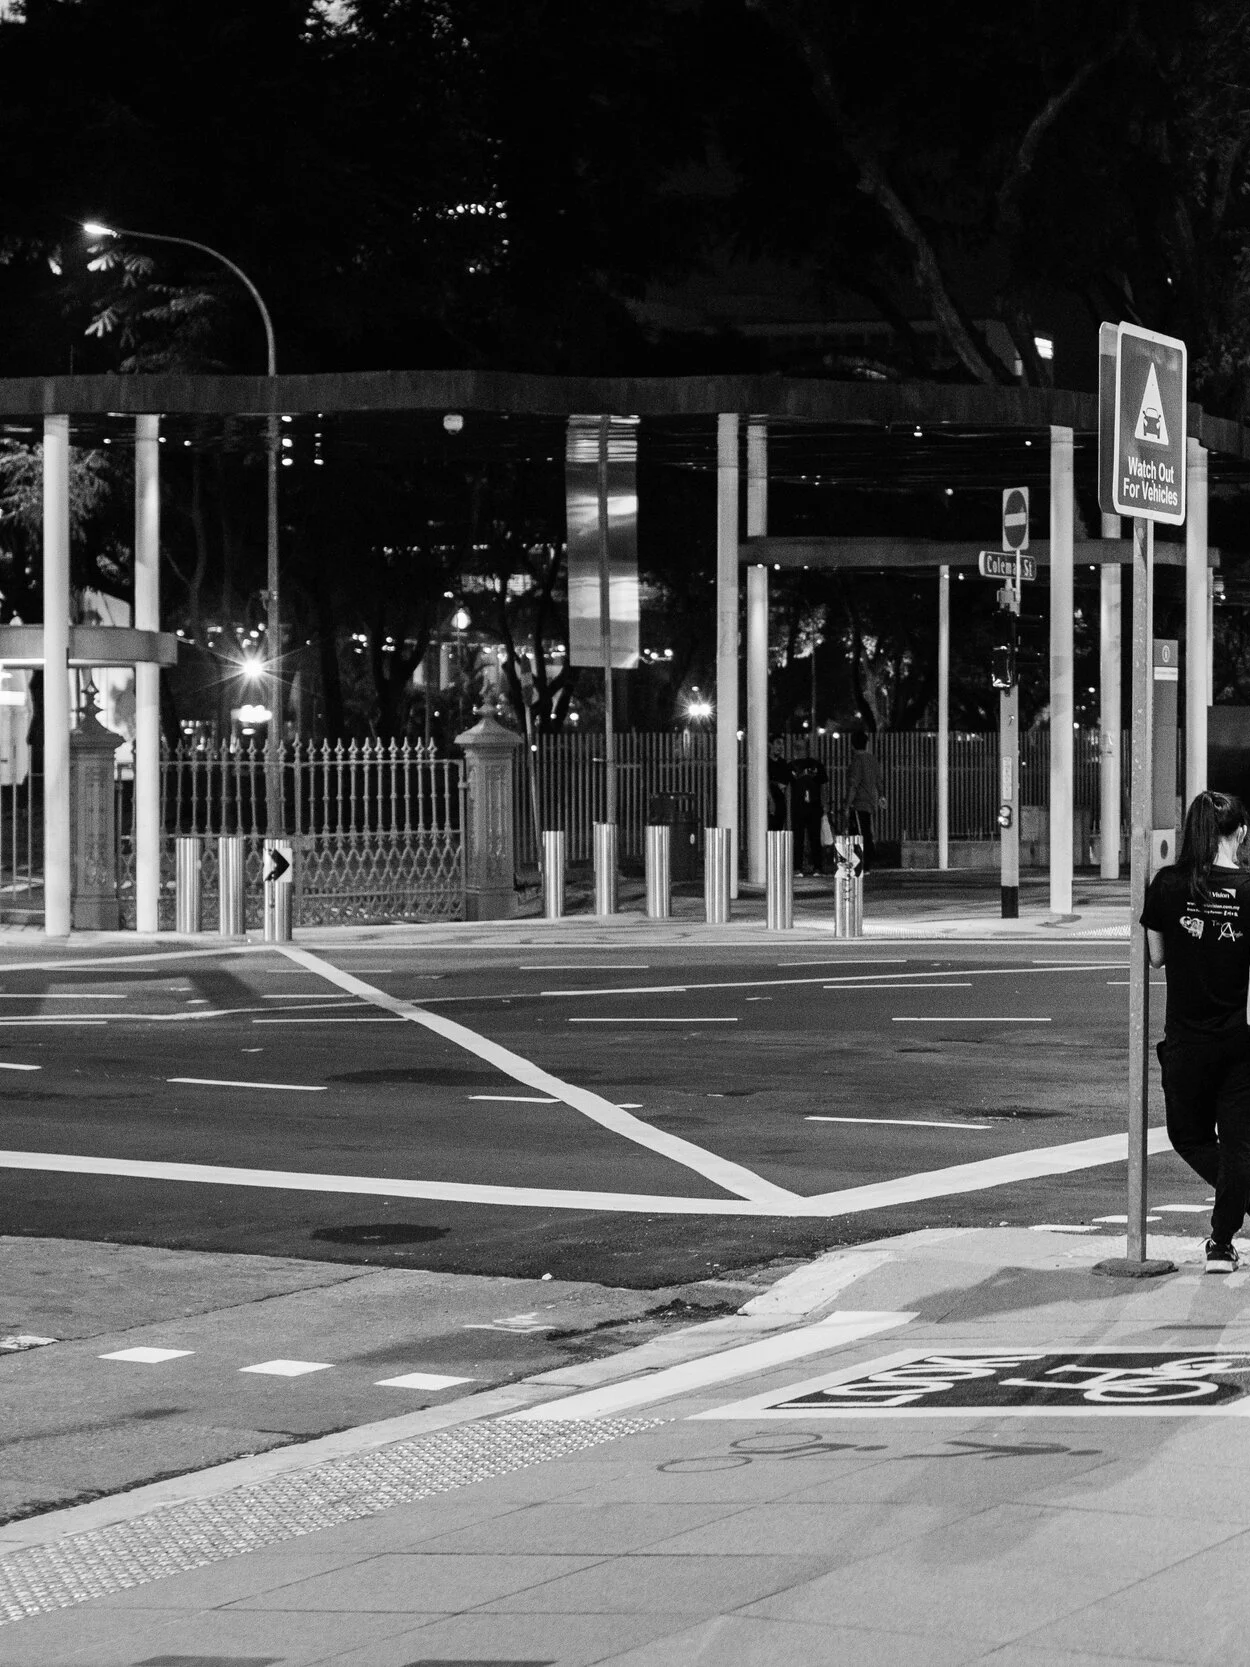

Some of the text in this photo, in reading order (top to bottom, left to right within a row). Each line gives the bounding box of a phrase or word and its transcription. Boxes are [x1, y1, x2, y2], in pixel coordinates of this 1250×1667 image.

[1128, 456, 1175, 484] Watch Out
[1123, 478, 1178, 507] For Vehicles
[986, 555, 1033, 577] Colema St
[776, 1354, 1046, 1408] LOOK
